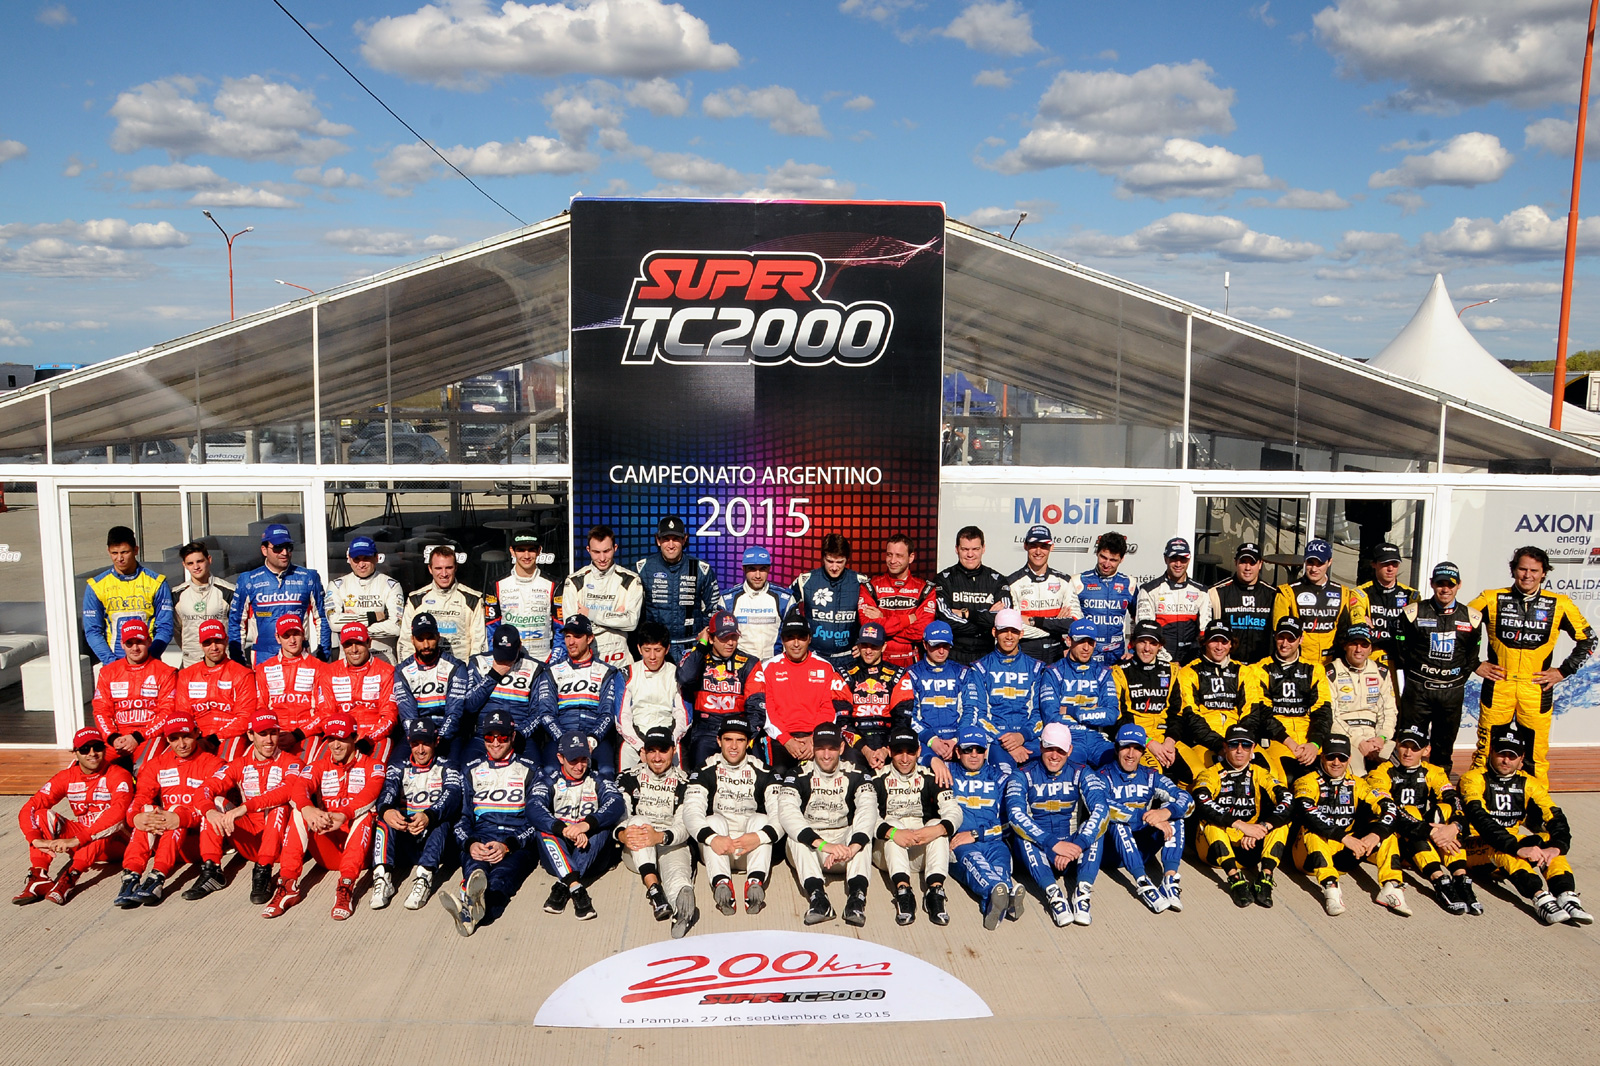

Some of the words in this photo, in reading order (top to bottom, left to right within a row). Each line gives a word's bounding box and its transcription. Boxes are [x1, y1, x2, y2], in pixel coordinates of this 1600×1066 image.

[638, 259, 817, 300] SUPER
[631, 306, 886, 358] TC2000
[609, 465, 756, 484] CAMPEONATO
[761, 466, 882, 485] ARGENTINO
[696, 497, 811, 537] 2015
[1014, 498, 1099, 525] Mobil
[1514, 514, 1594, 533] AXION
[1064, 535, 1093, 544] Oficial
[1556, 536, 1591, 545] energy
[1563, 548, 1588, 556] Oficial
[1557, 579, 1600, 590] CALIDA
[255, 592, 302, 603] CartaSur
[878, 599, 916, 608] Biotenk
[952, 592, 986, 604] Blanco
[1030, 599, 1060, 609] SCIENZA
[1083, 599, 1122, 610] SCIENZA
[1299, 608, 1339, 617] RENAULT
[1230, 615, 1267, 627] Lukas
[1500, 618, 1548, 630] RENAULT
[123, 625, 144, 633] TOYOTA
[200, 625, 220, 633] TOYOTA
[342, 626, 363, 634] TOYOTA
[1432, 641, 1452, 653] MD
[604, 652, 625, 663] 10
[990, 671, 1029, 684] YPF
[560, 680, 600, 694] 408
[921, 679, 957, 691] YPF
[1064, 679, 1098, 692] YPF
[1131, 688, 1170, 698] RENAULT
[703, 695, 737, 710] SKY
[856, 705, 886, 717] SKY
[167, 717, 189, 726] TOYOTA
[256, 714, 277, 722] TOYOTA
[327, 719, 347, 727] TOYOTA
[77, 729, 101, 738] TOYOTA
[955, 778, 996, 793] YPF
[1033, 781, 1075, 797] YPF
[1112, 783, 1150, 799] YPF
[473, 789, 524, 803] 408
[701, 1015, 719, 1023] 27
[746, 1013, 828, 1023] septiembre
[855, 1010, 891, 1019] 2015
